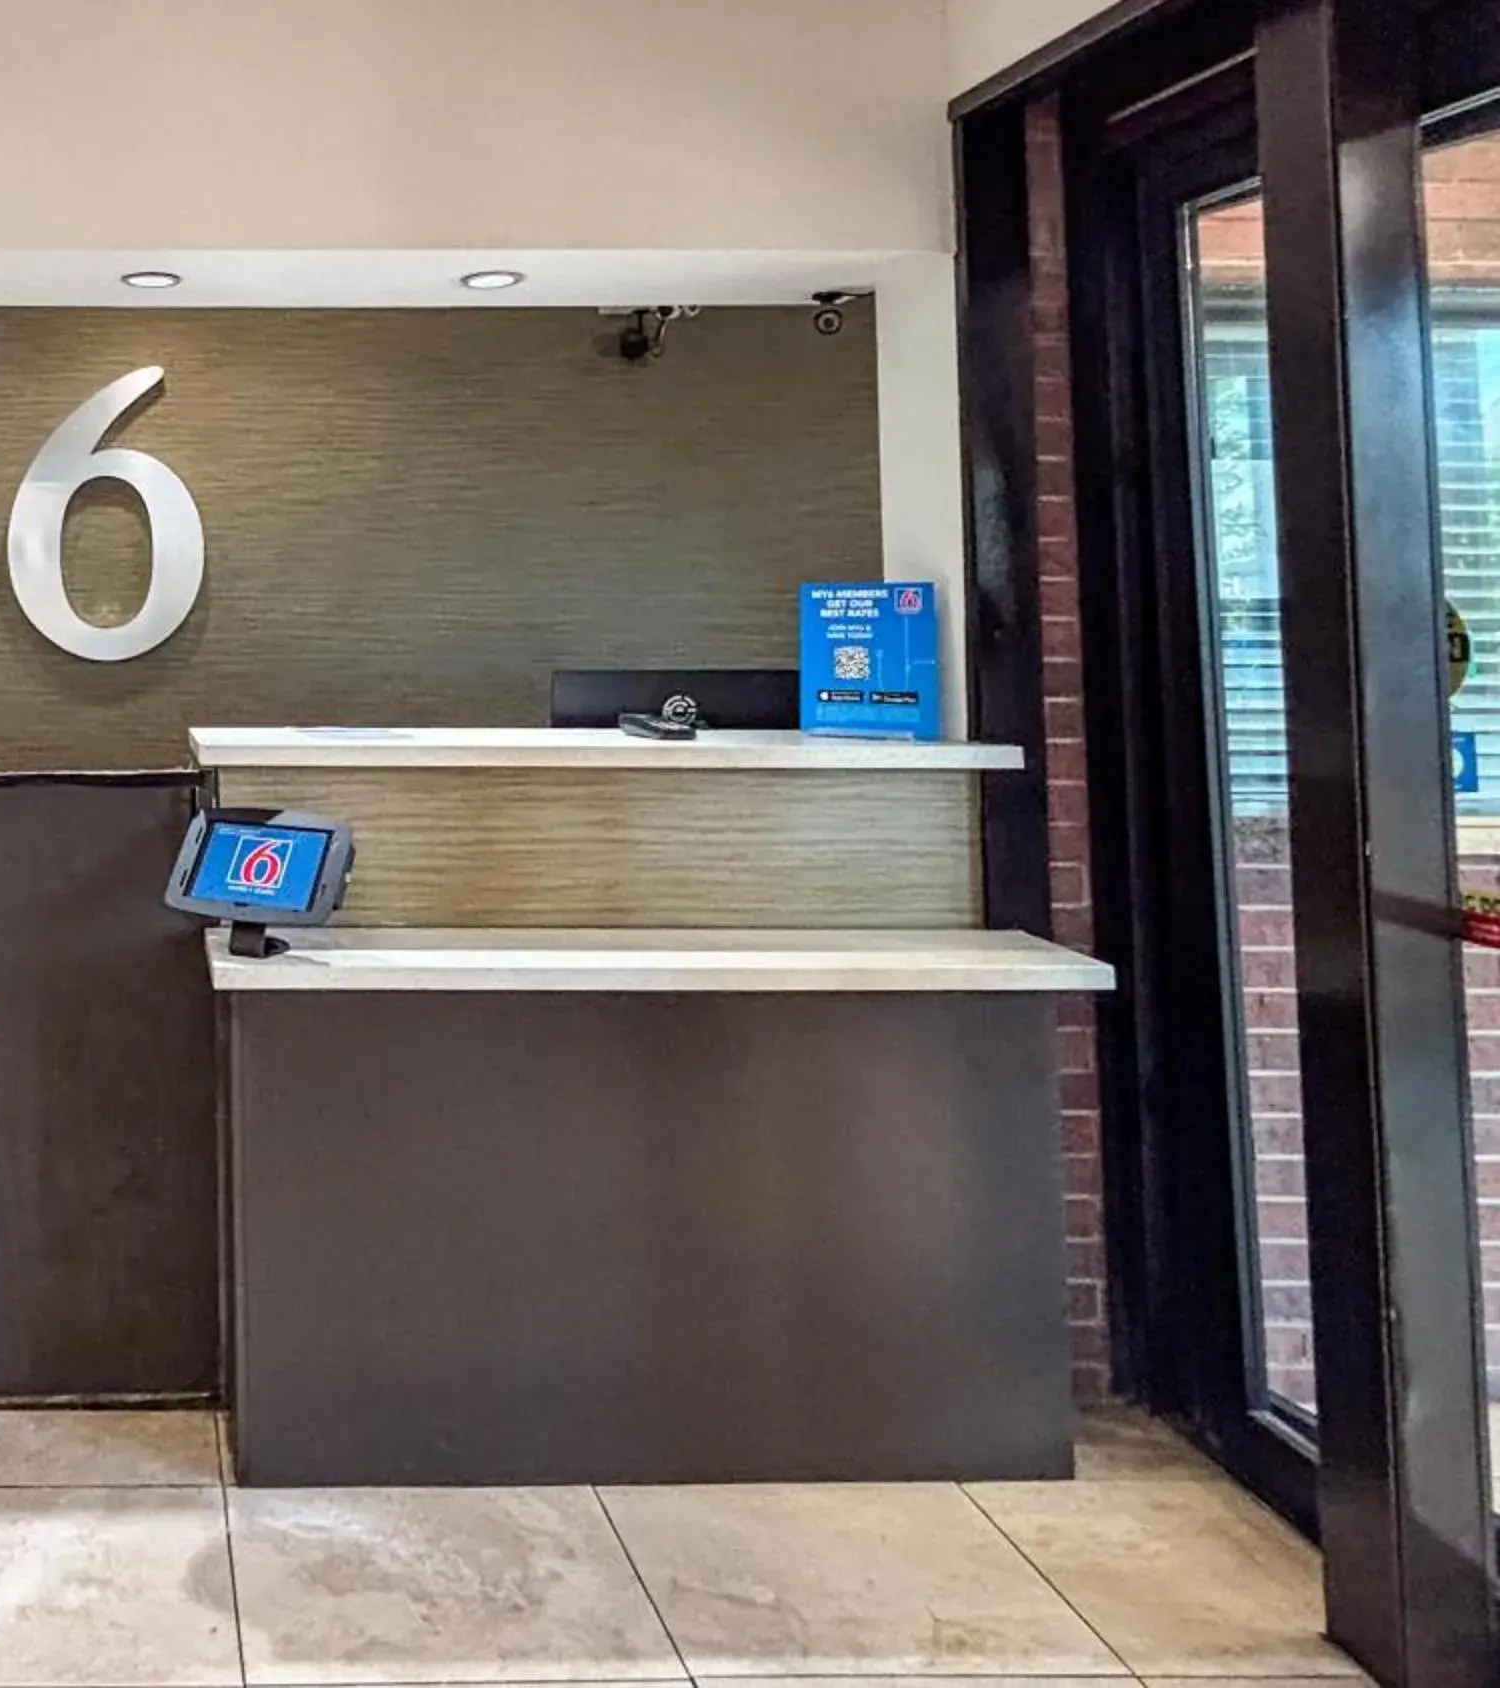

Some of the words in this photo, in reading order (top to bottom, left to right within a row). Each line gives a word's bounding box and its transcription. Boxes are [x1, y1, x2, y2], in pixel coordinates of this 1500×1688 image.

[7, 365, 204, 662] 6
[820, 608, 845, 618] BEST
[847, 608, 880, 618] RATES
[826, 599, 846, 609] GET
[849, 599, 873, 609] OUR
[240, 840, 282, 886] 6
